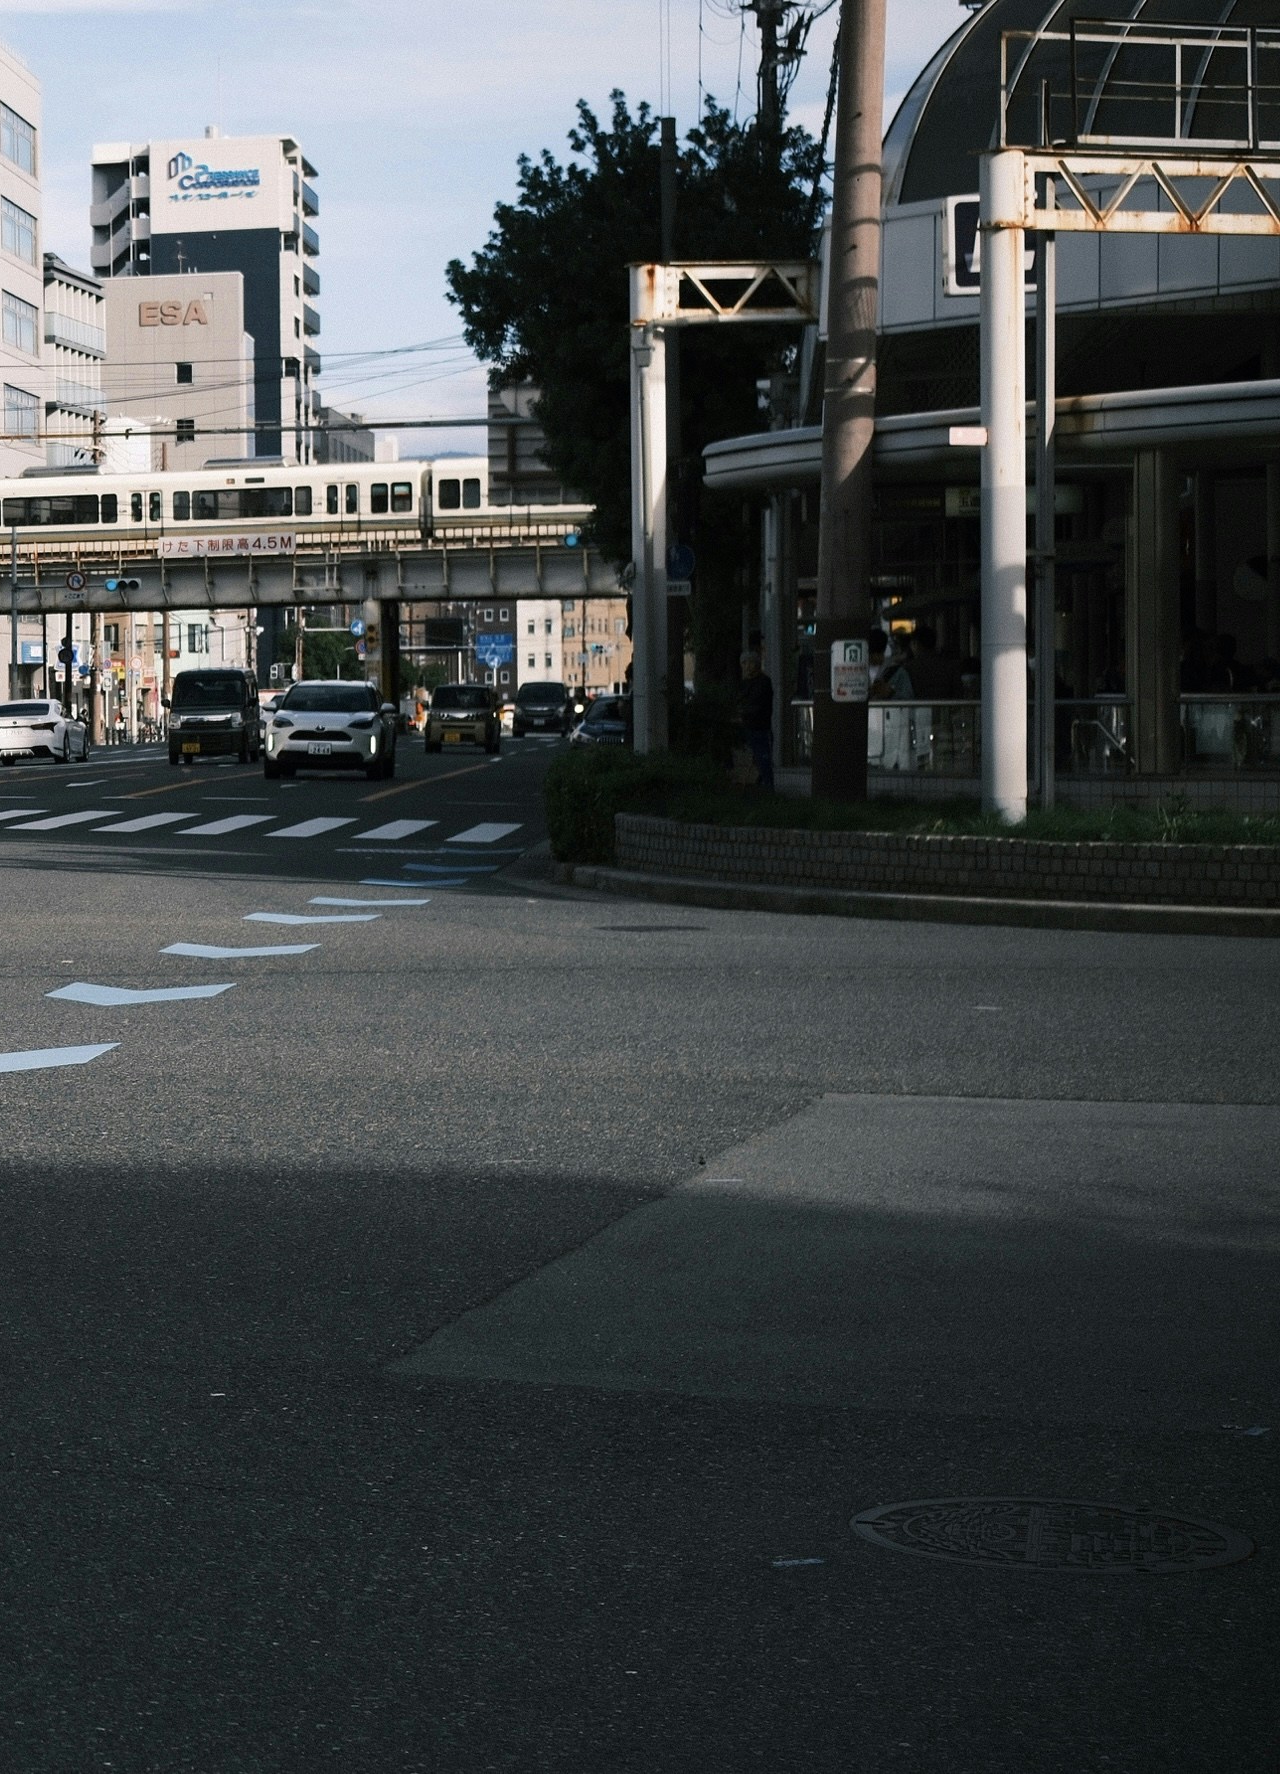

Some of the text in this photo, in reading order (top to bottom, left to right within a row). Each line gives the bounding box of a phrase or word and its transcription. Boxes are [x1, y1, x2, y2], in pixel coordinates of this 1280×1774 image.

[139, 300, 208, 327] ESA
[162, 536, 292, 553] けた下制限高4.5M
